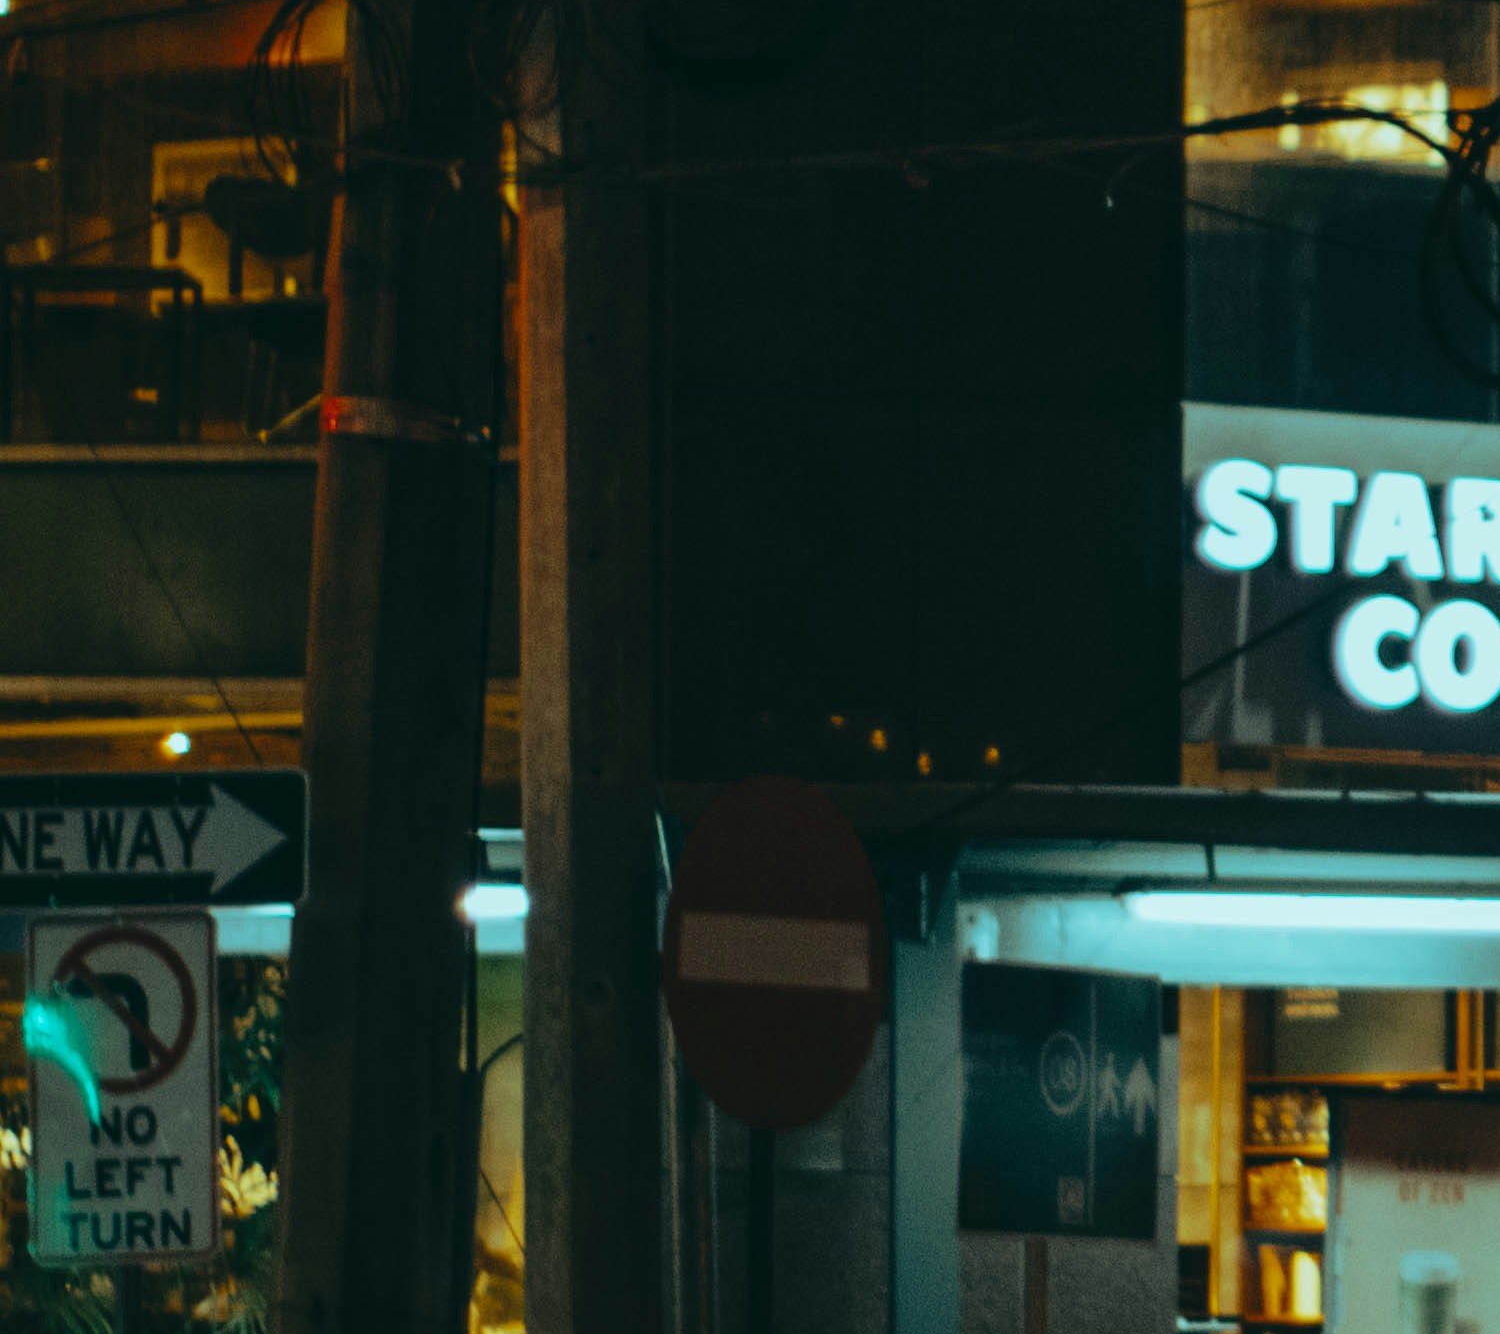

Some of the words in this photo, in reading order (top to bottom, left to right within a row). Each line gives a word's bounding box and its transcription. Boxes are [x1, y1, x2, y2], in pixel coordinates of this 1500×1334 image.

[0, 808, 65, 871] NE
[82, 806, 207, 869] WAY
[90, 1105, 157, 1145] NO
[64, 1157, 182, 1199] LEFT
[60, 1208, 191, 1252] TURN
